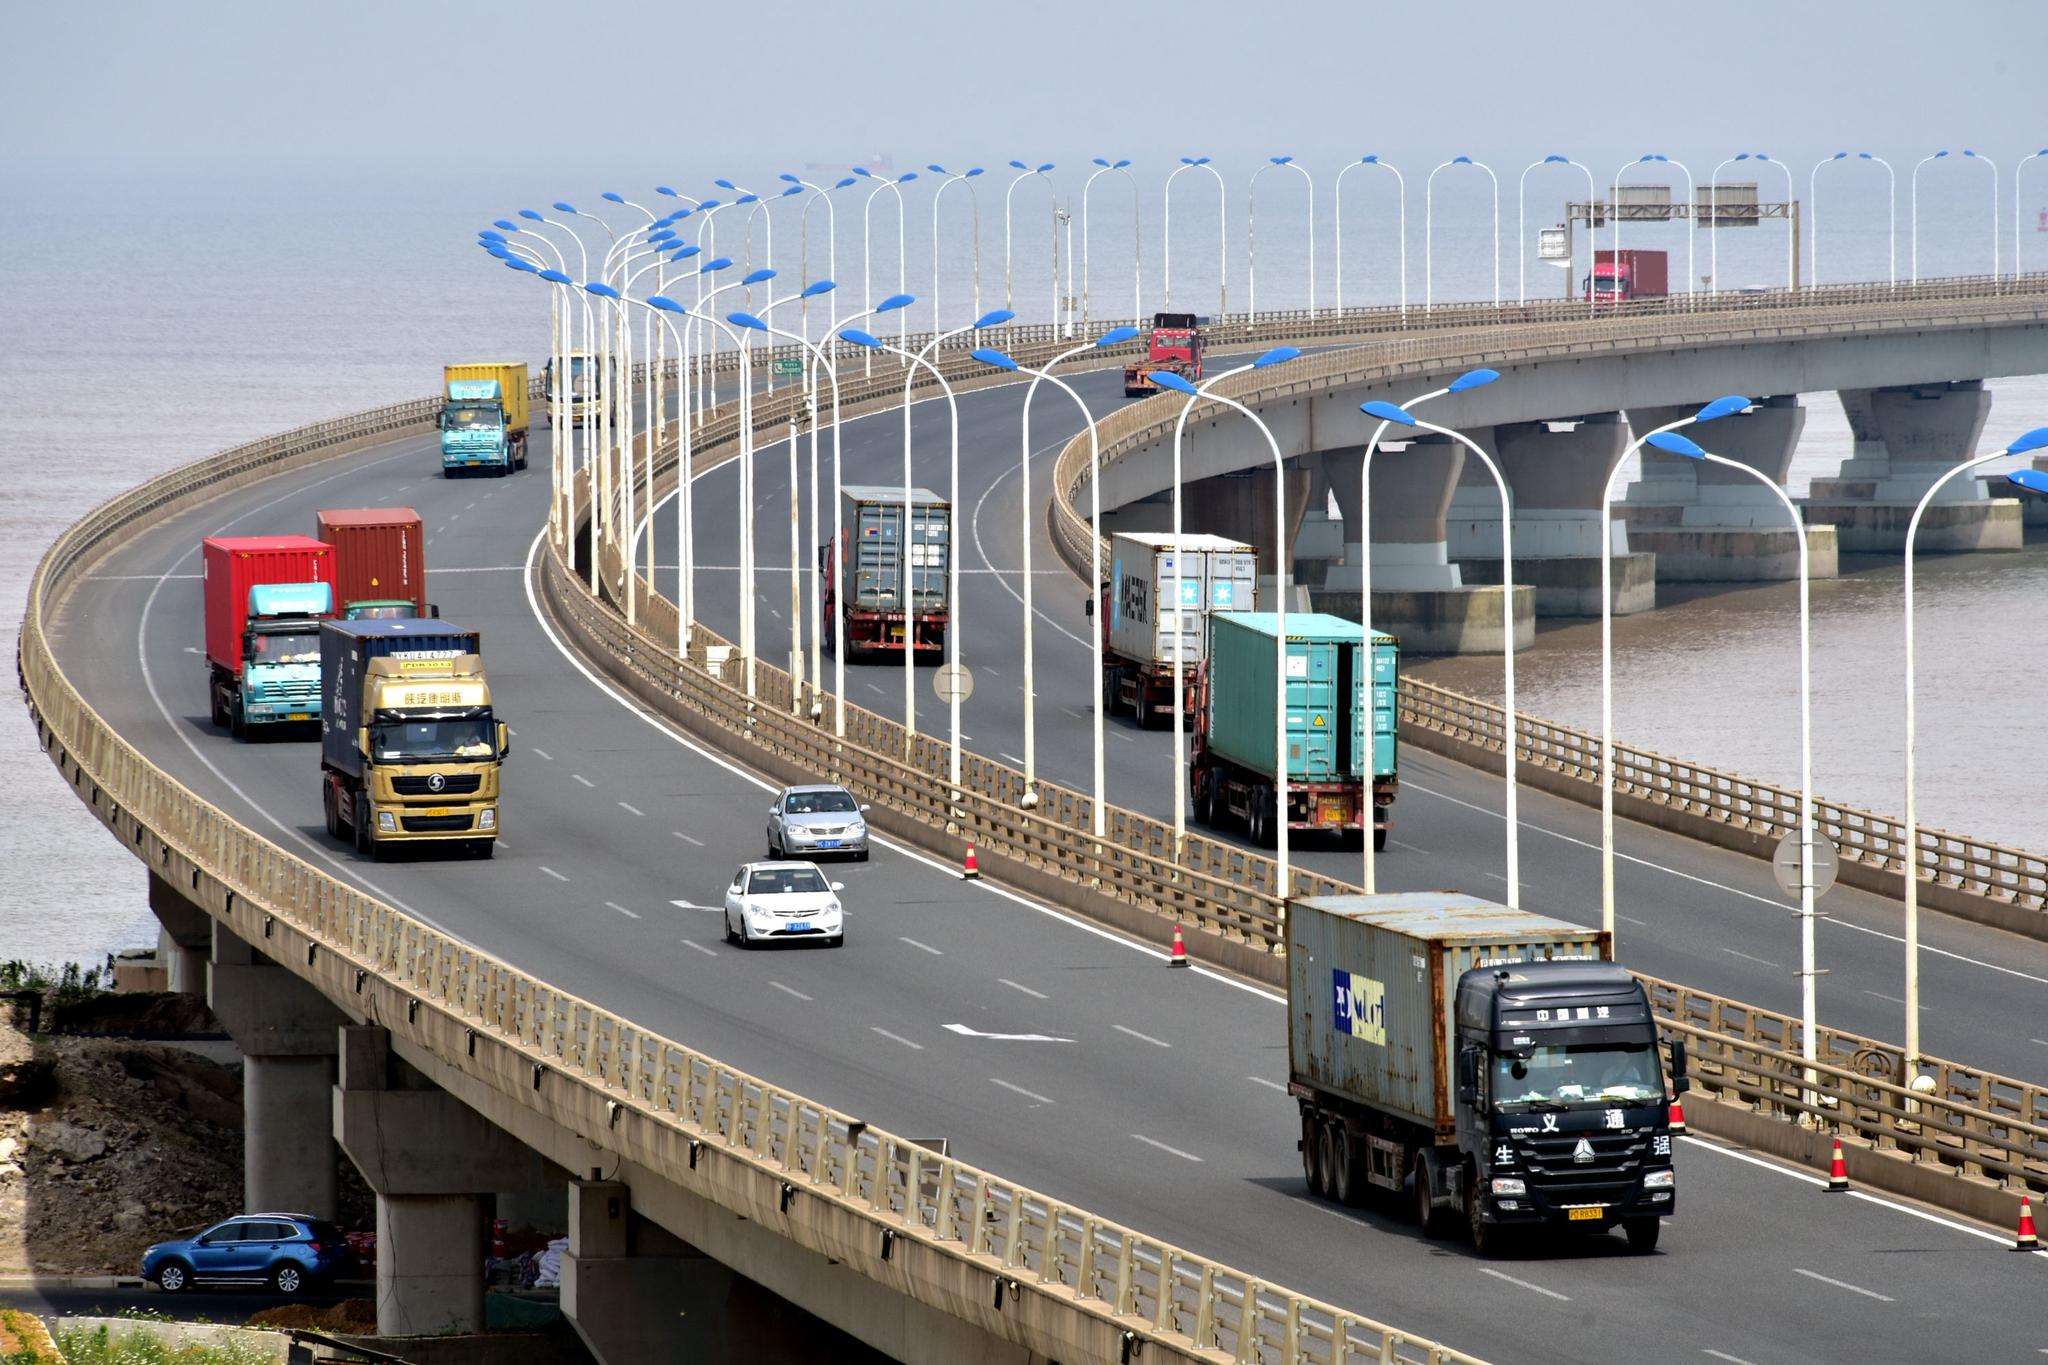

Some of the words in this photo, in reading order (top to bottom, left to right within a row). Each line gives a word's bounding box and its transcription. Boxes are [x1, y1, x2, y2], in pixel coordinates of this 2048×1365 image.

[1541, 1113, 1560, 1133] 义
[1605, 1108, 1625, 1129] 通
[1494, 1144, 1515, 1166] 生
[1653, 1135, 1672, 1157] 强
